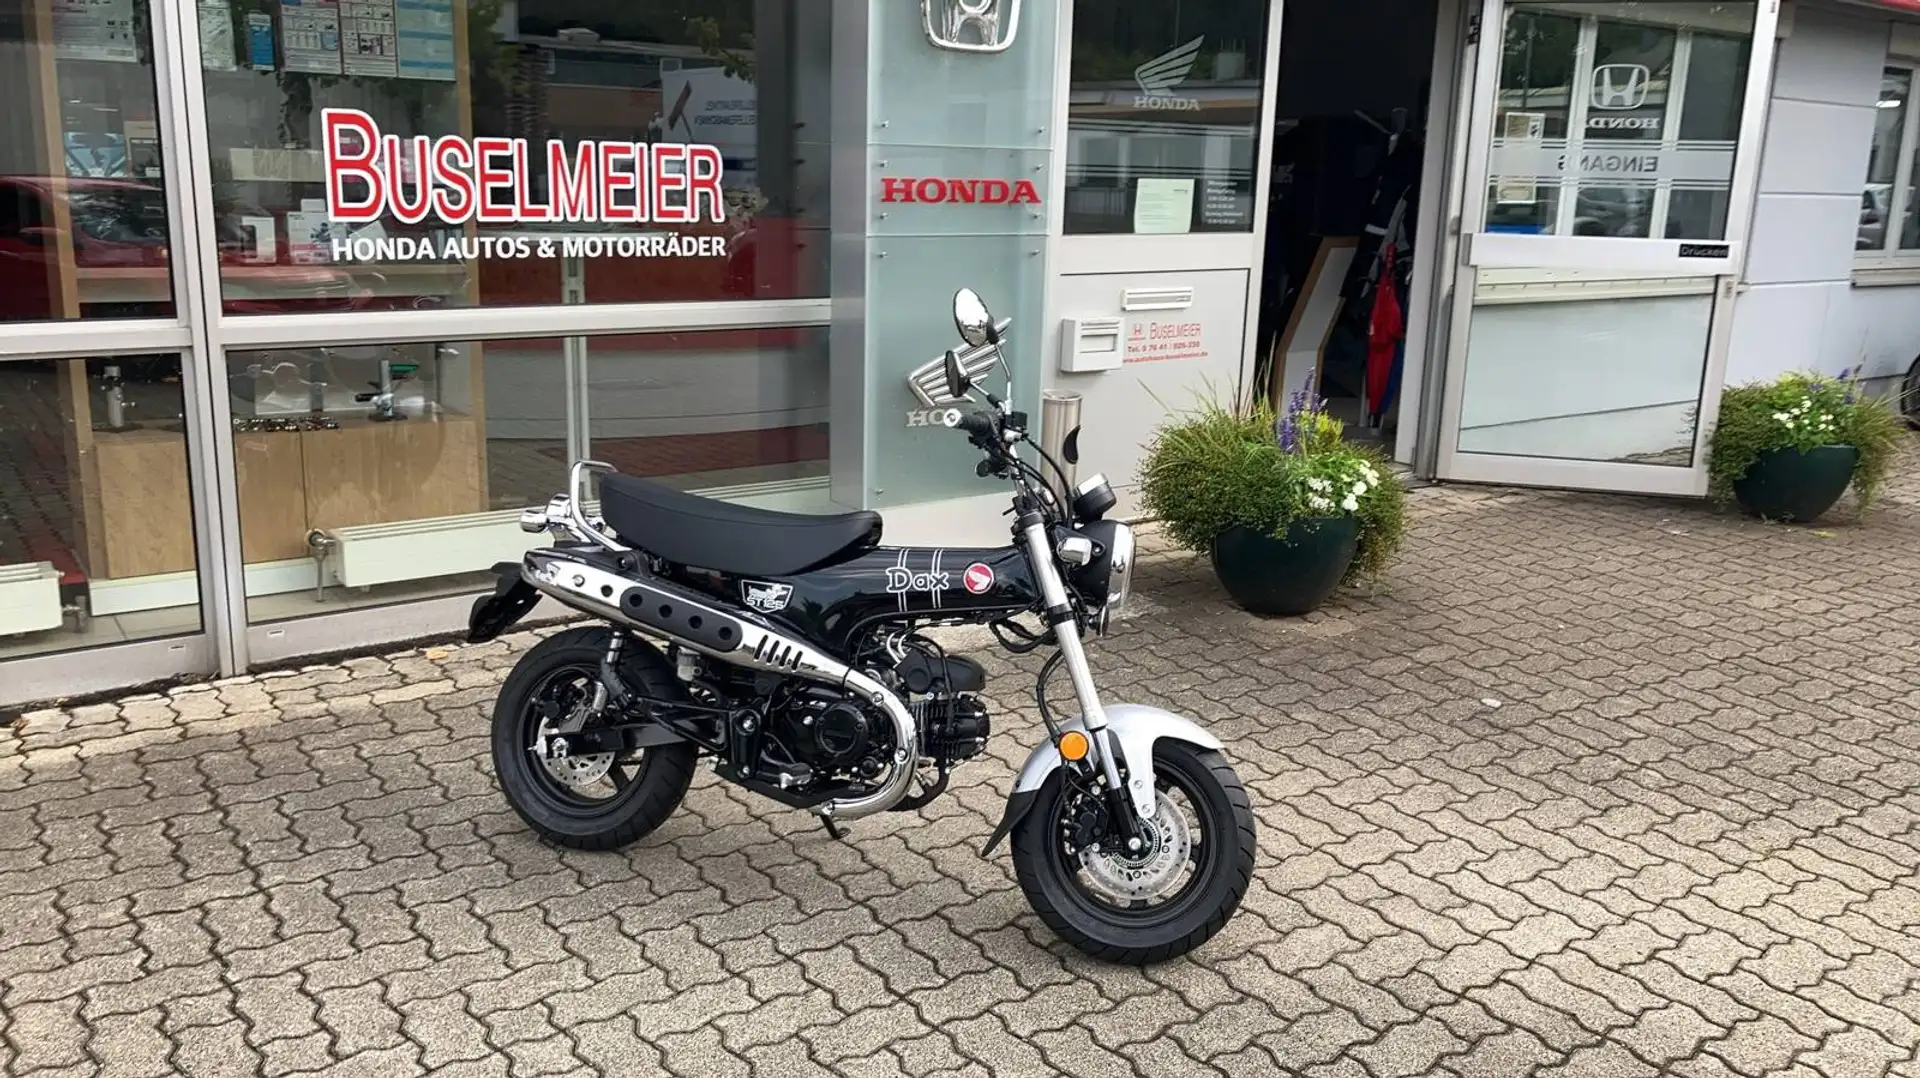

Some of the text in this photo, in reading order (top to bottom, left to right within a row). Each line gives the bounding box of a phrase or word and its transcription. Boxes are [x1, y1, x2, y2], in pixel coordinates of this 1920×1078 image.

[1133, 95, 1201, 111] HONDA
[321, 107, 726, 224] BUSELMEIER
[881, 178, 1042, 204] HONDA
[332, 238, 441, 261] HONDA
[442, 239, 531, 260] AUTOS
[537, 238, 556, 259] &
[562, 231, 727, 259] MOTORRÄDER
[886, 567, 950, 593] Dax
